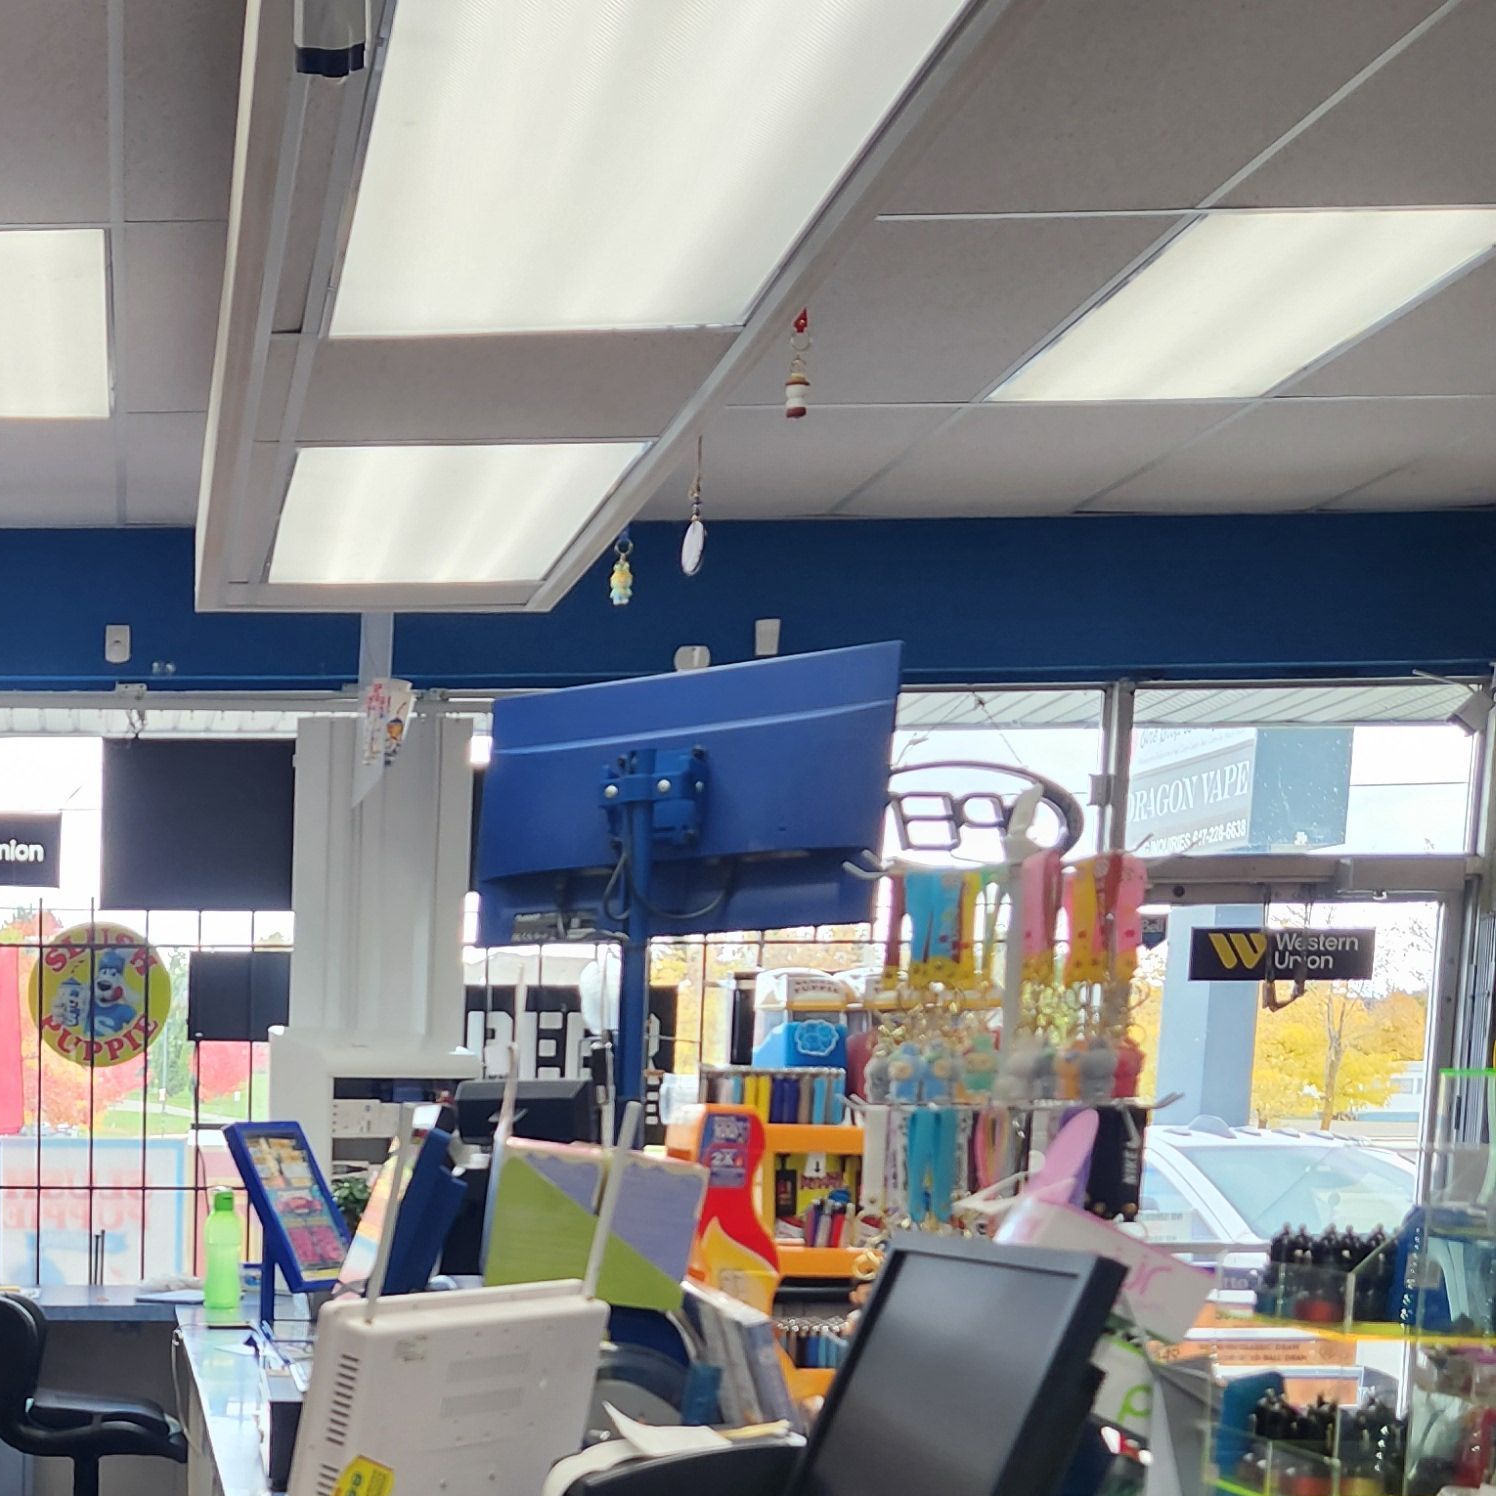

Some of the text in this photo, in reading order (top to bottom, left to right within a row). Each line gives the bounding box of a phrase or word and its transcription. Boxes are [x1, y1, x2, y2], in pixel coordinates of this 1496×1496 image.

[1201, 760, 1251, 805] VAPE
[1274, 932, 1359, 951] Western
[1274, 951, 1334, 970] Unon
